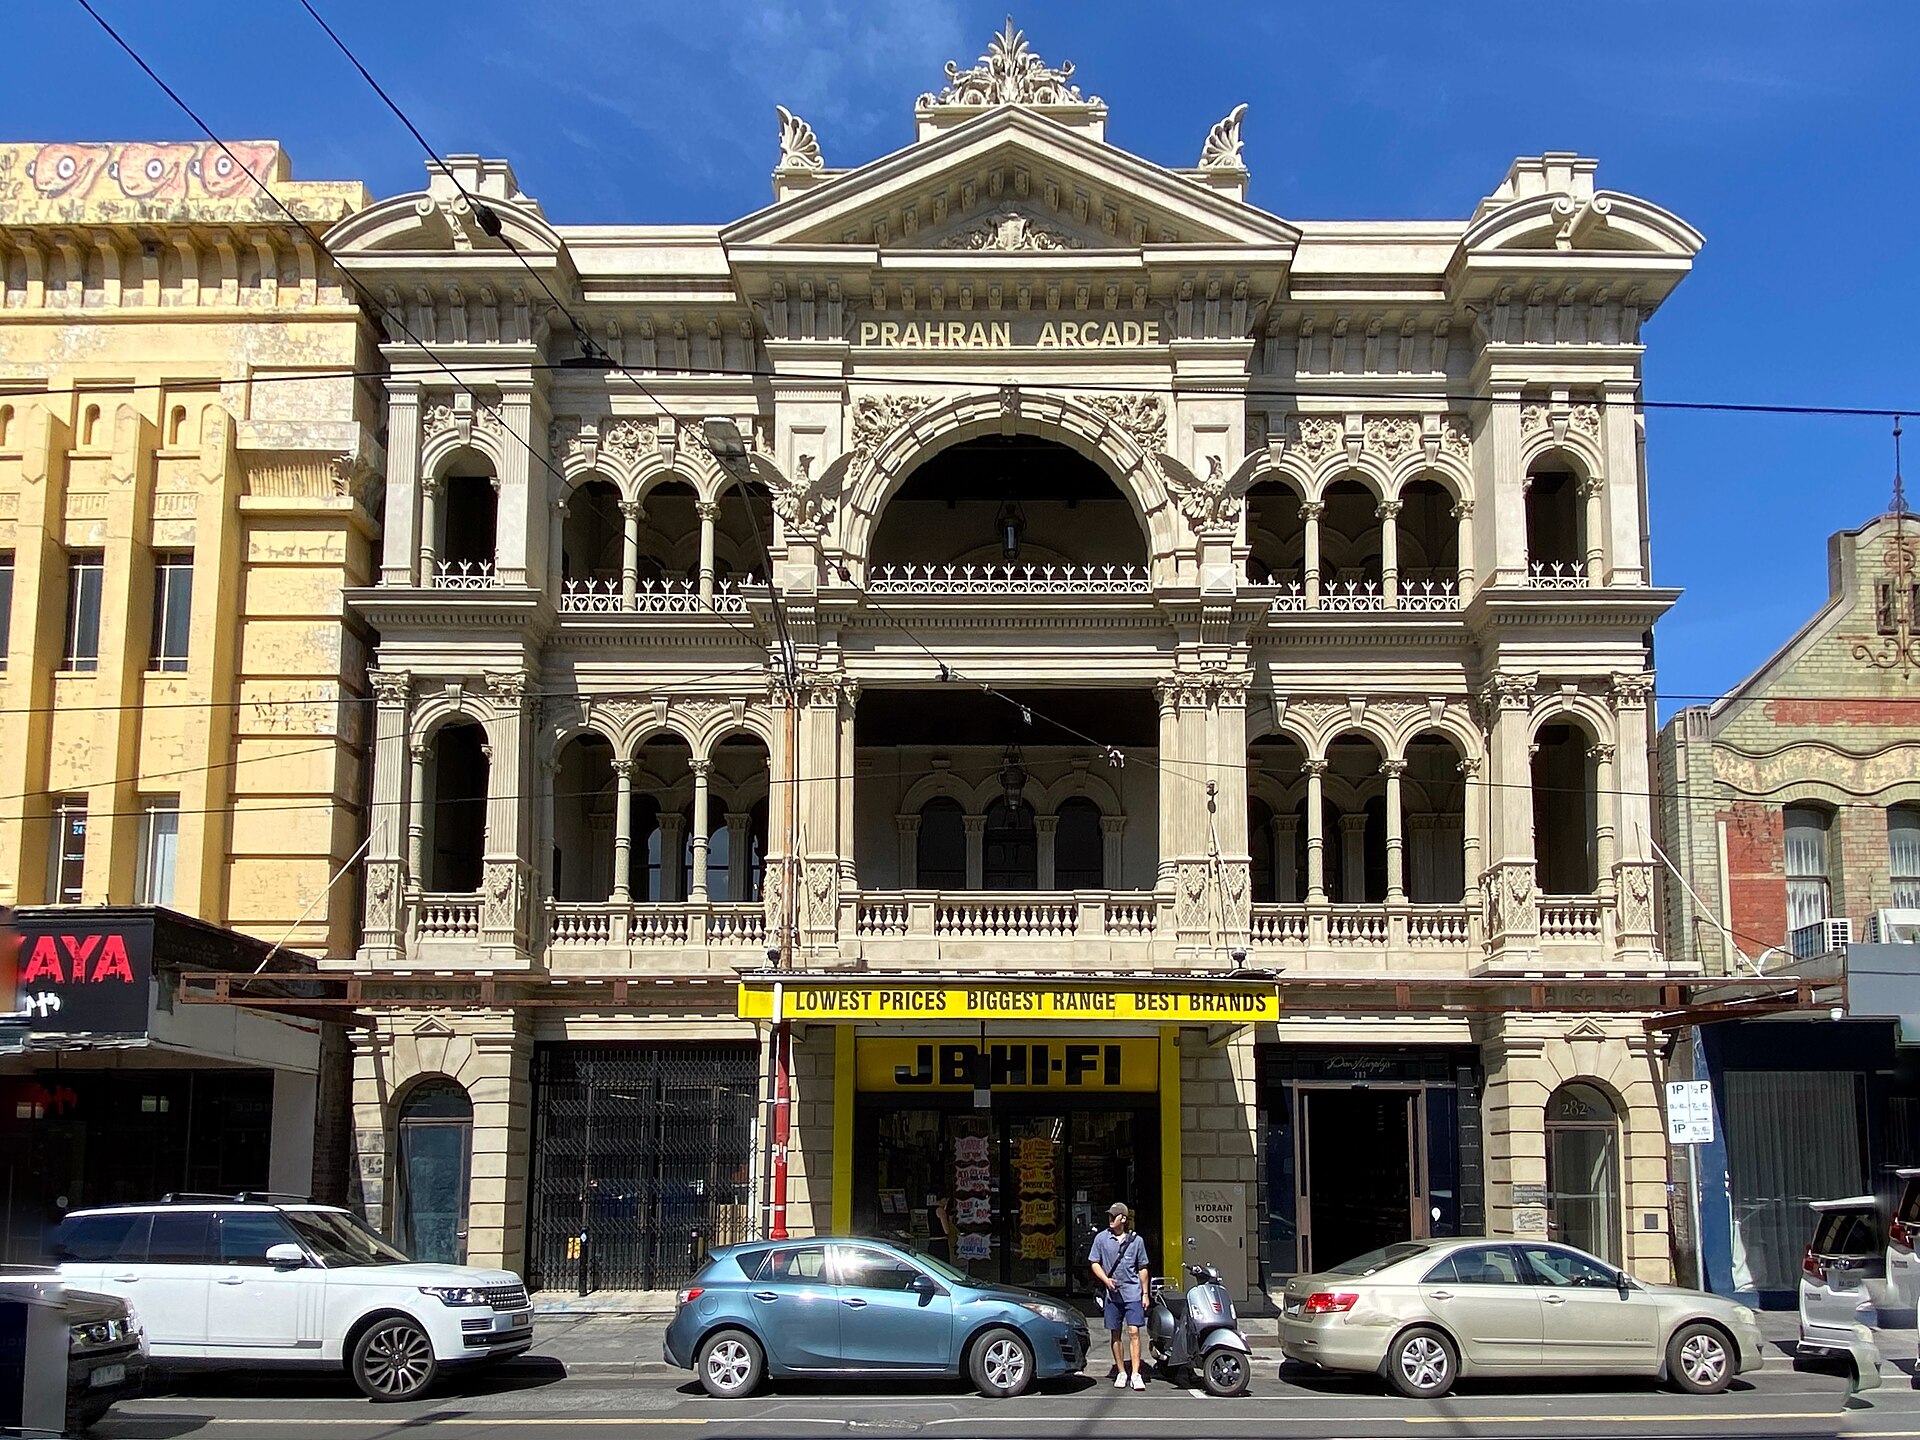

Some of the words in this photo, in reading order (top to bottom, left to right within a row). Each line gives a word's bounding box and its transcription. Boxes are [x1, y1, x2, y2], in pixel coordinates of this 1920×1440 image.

[860, 321, 1011, 348] PRAHRAN
[1037, 321, 1159, 348] ARCADE
[20, 935, 134, 983] AYA
[796, 991, 872, 1011] LOWEST
[880, 991, 947, 1011] PRICES
[967, 991, 1045, 1011] BIGGEST
[1053, 992, 1115, 1011] RANGE
[1135, 992, 1180, 1011] BEST
[1190, 992, 1267, 1012] BRANDS
[894, 1044, 978, 1086] JB
[1672, 1084, 1684, 1094] 1P
[1561, 1100, 1587, 1116] 282
[1673, 1123, 1686, 1134] 1P
[1194, 1203, 1233, 1212] HYDRANT
[1195, 1215, 1233, 1223] BOOSTER
